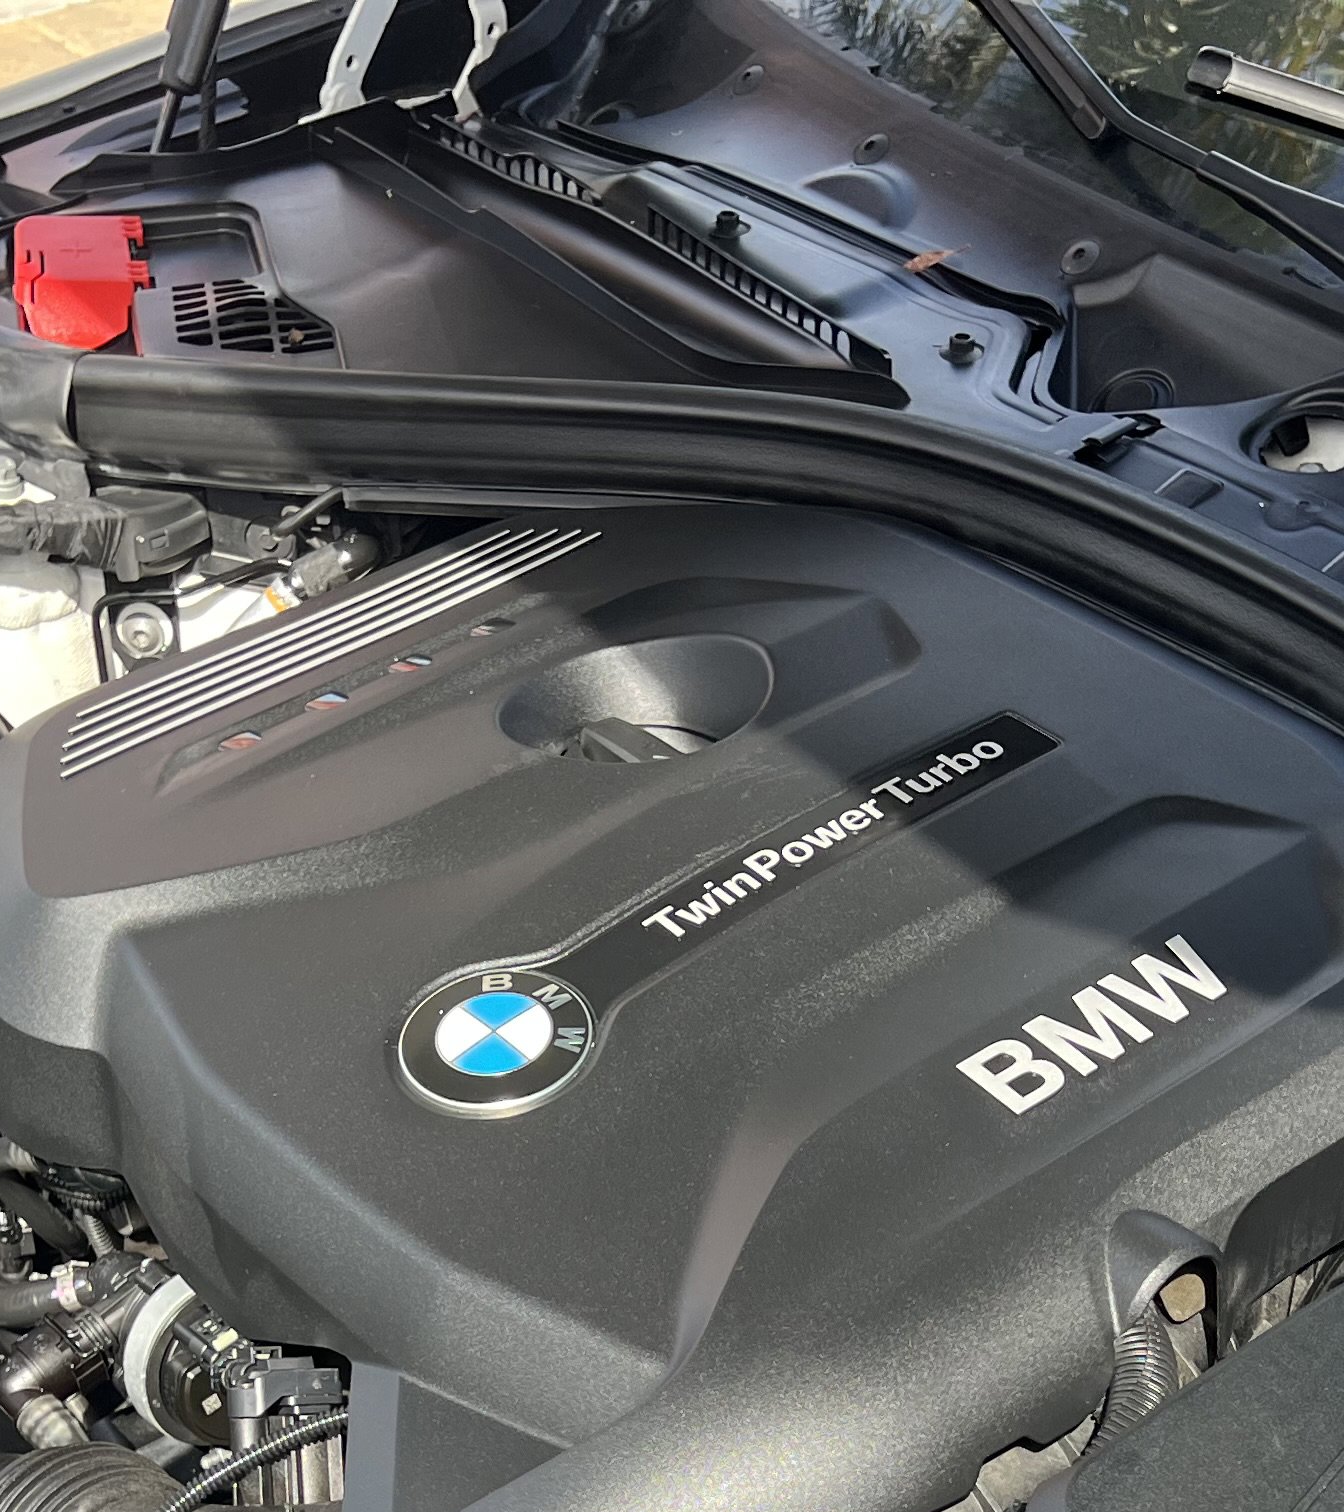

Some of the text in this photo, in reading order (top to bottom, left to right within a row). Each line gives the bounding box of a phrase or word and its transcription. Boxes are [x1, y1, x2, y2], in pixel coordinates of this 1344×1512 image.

[641, 735, 1005, 943] TwinPower Turbo
[480, 970, 587, 1055] BMW
[955, 934, 1227, 1116] BMW
